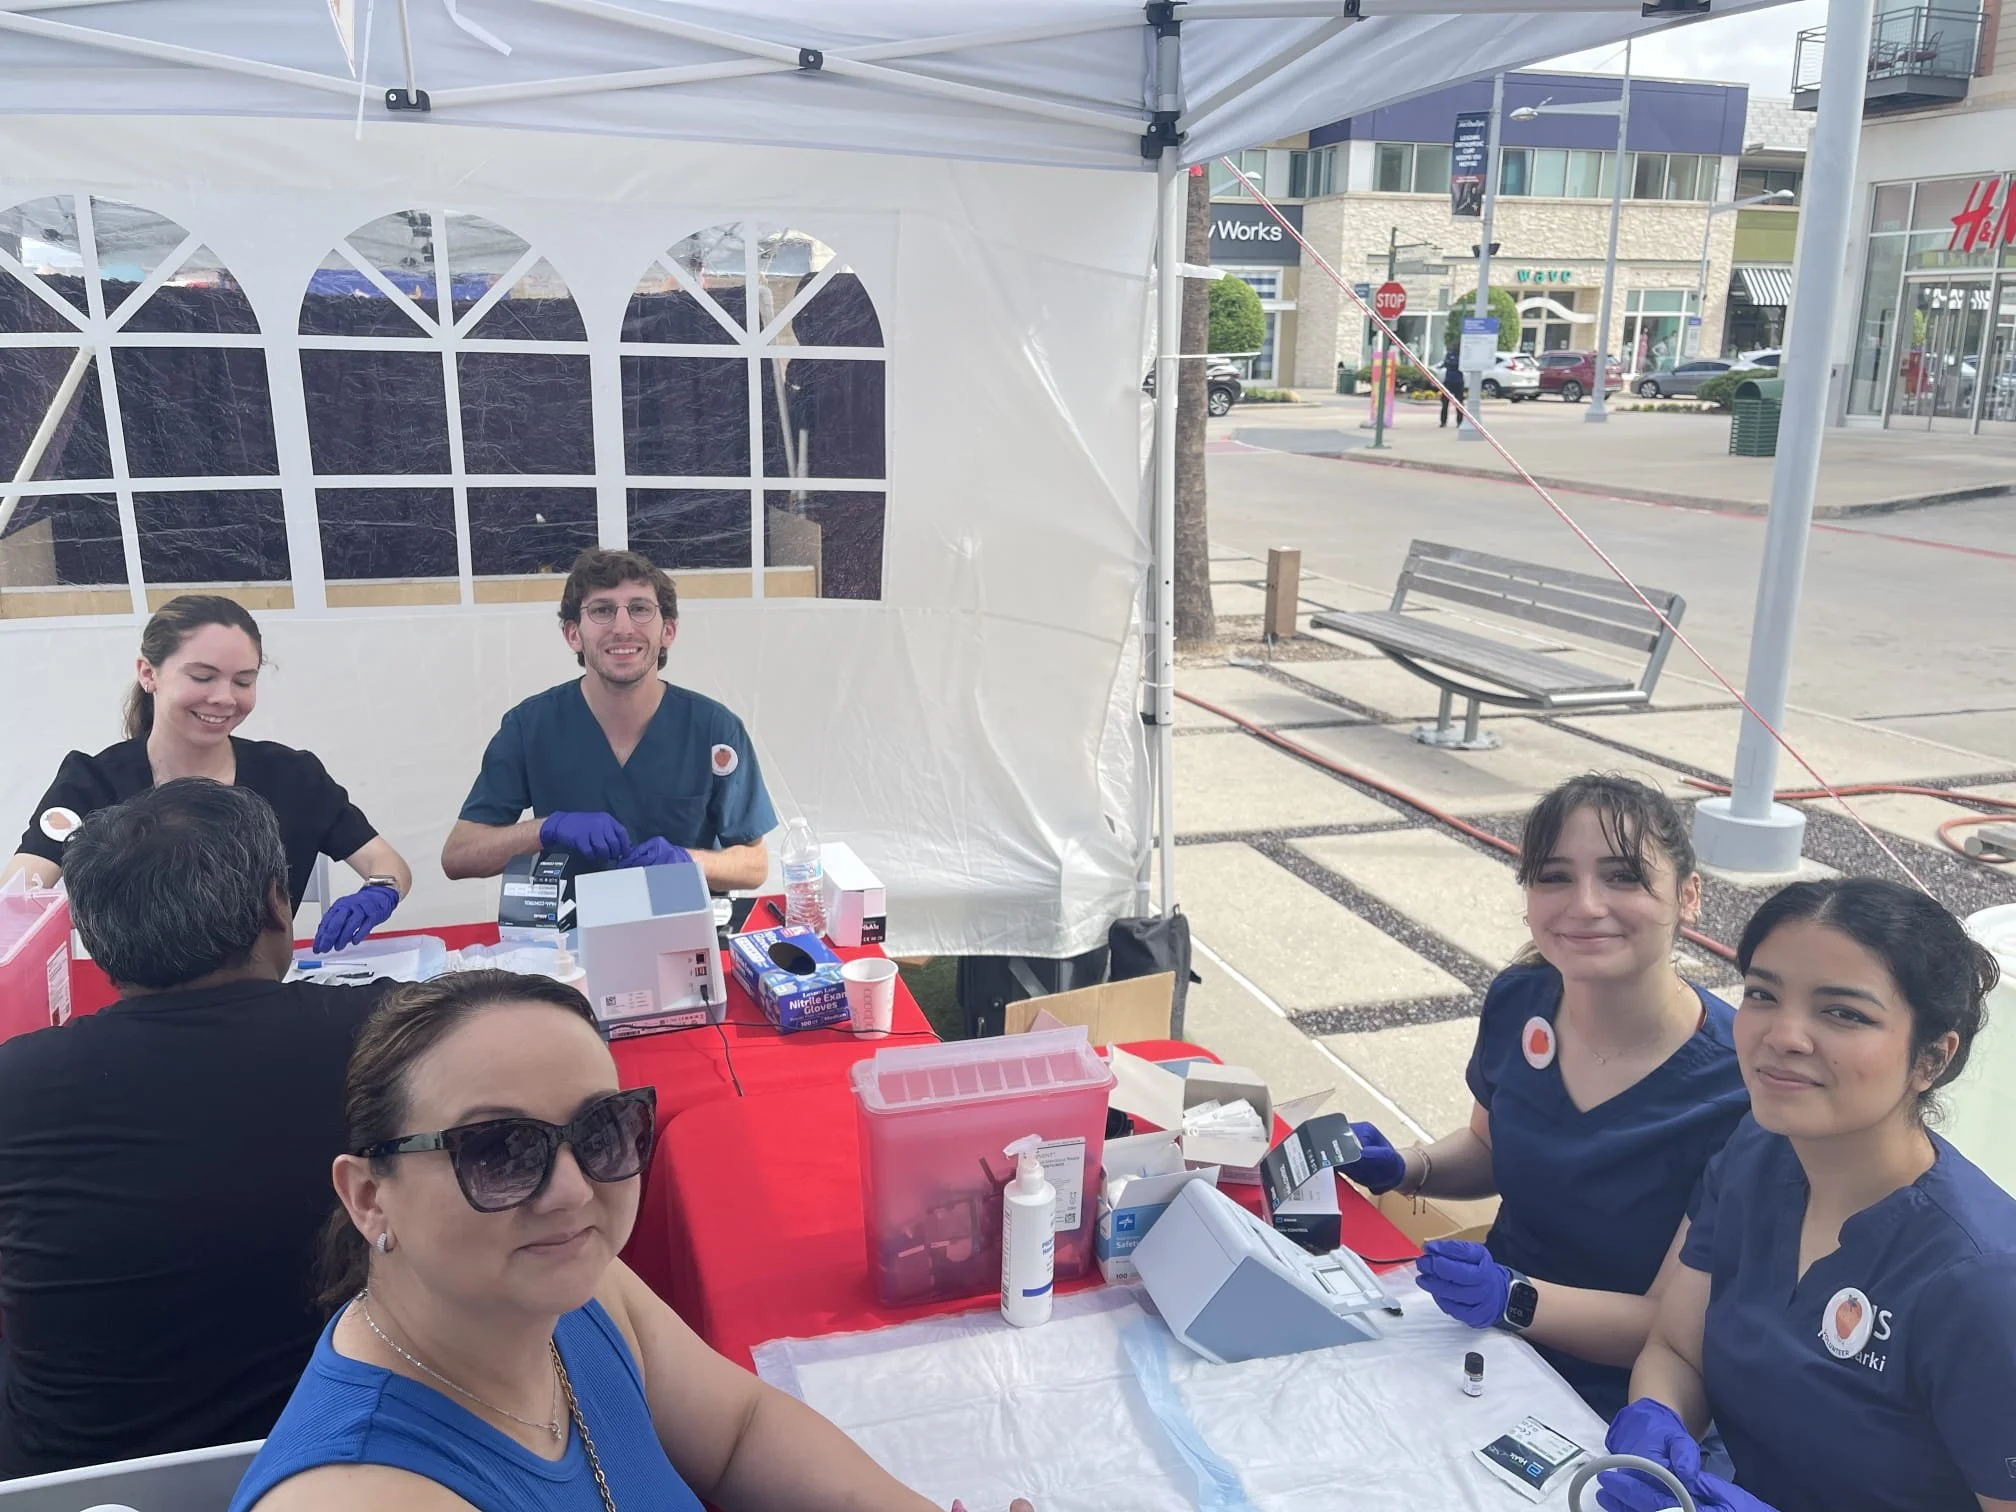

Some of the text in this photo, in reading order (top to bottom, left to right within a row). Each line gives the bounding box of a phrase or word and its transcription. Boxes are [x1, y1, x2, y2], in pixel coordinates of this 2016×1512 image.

[1217, 220, 1283, 241] Works
[1376, 293, 1405, 308] STOP
[789, 996, 822, 1010] Nitrile
[803, 1001, 838, 1015] Gloves
[1823, 1329, 1850, 1357] VOLUNTEER
